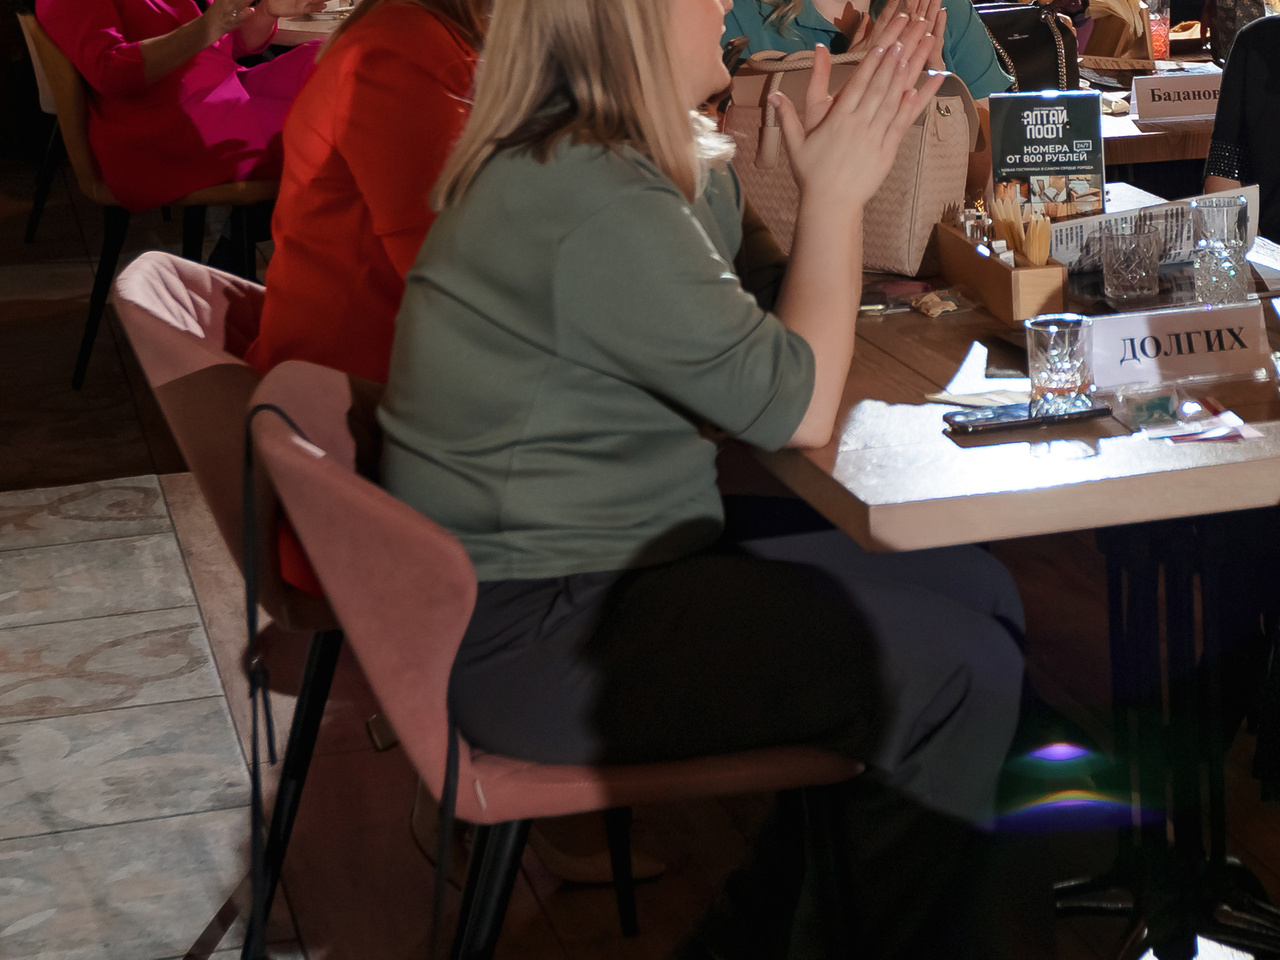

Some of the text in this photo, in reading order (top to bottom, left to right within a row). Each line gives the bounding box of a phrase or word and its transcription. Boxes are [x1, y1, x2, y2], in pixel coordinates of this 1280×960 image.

[1023, 144, 1070, 154] НОМЕРА
[1006, 151, 1088, 163] ОТ 800 РУБЛЕЙ
[1119, 326, 1249, 366] ДОЛГИХ
